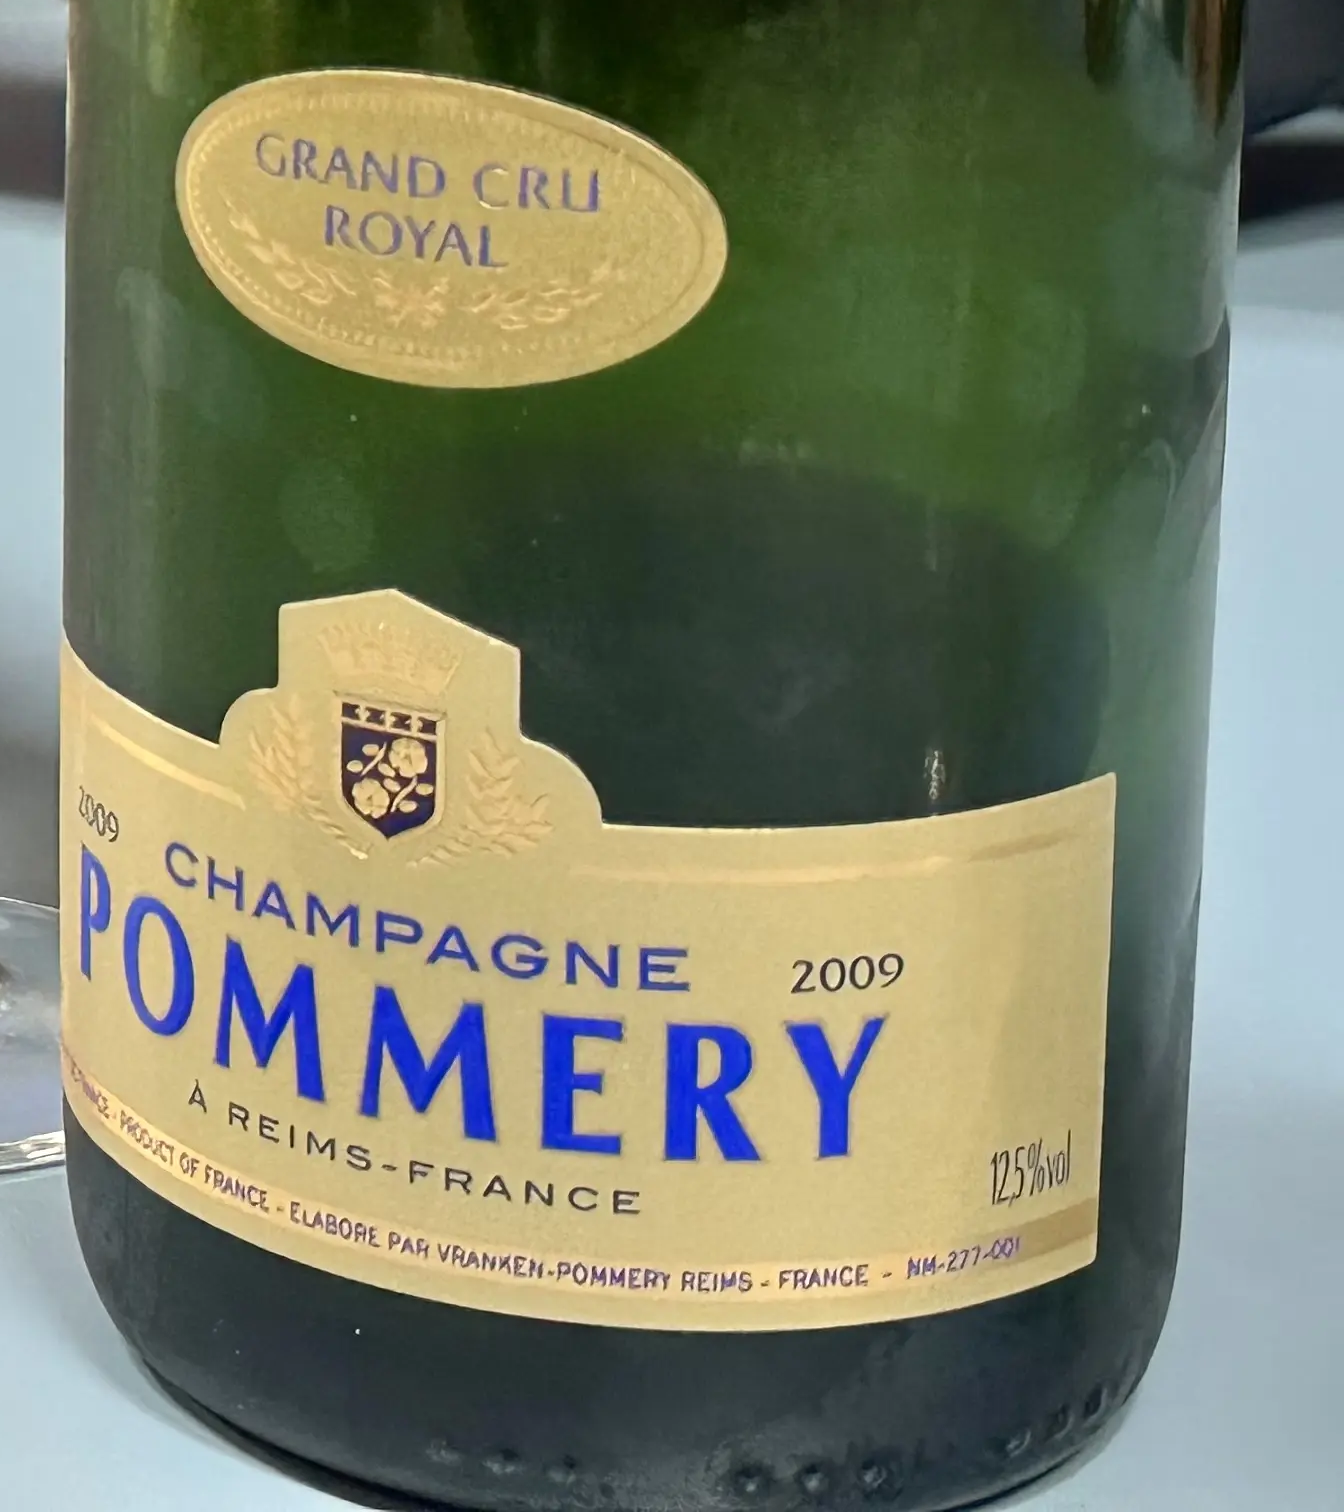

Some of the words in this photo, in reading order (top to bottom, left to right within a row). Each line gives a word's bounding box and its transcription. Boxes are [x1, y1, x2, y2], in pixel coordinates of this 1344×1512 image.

[255, 132, 446, 201] GRAND
[473, 161, 601, 214] CRU
[324, 205, 509, 270] ROYAL
[78, 785, 120, 843] 2009
[164, 841, 691, 992] CHAMPAGNE
[79, 840, 888, 1162] POMMERY
[790, 953, 905, 994] 2009
[228, 1100, 642, 1215] REIMS-FRANCE
[179, 1150, 200, 1178] OF
[204, 1163, 270, 1213] FRANCE
[388, 1230, 430, 1259] PAR
[680, 1270, 754, 1293] REIMS
[778, 1263, 869, 1291] FRANCE
